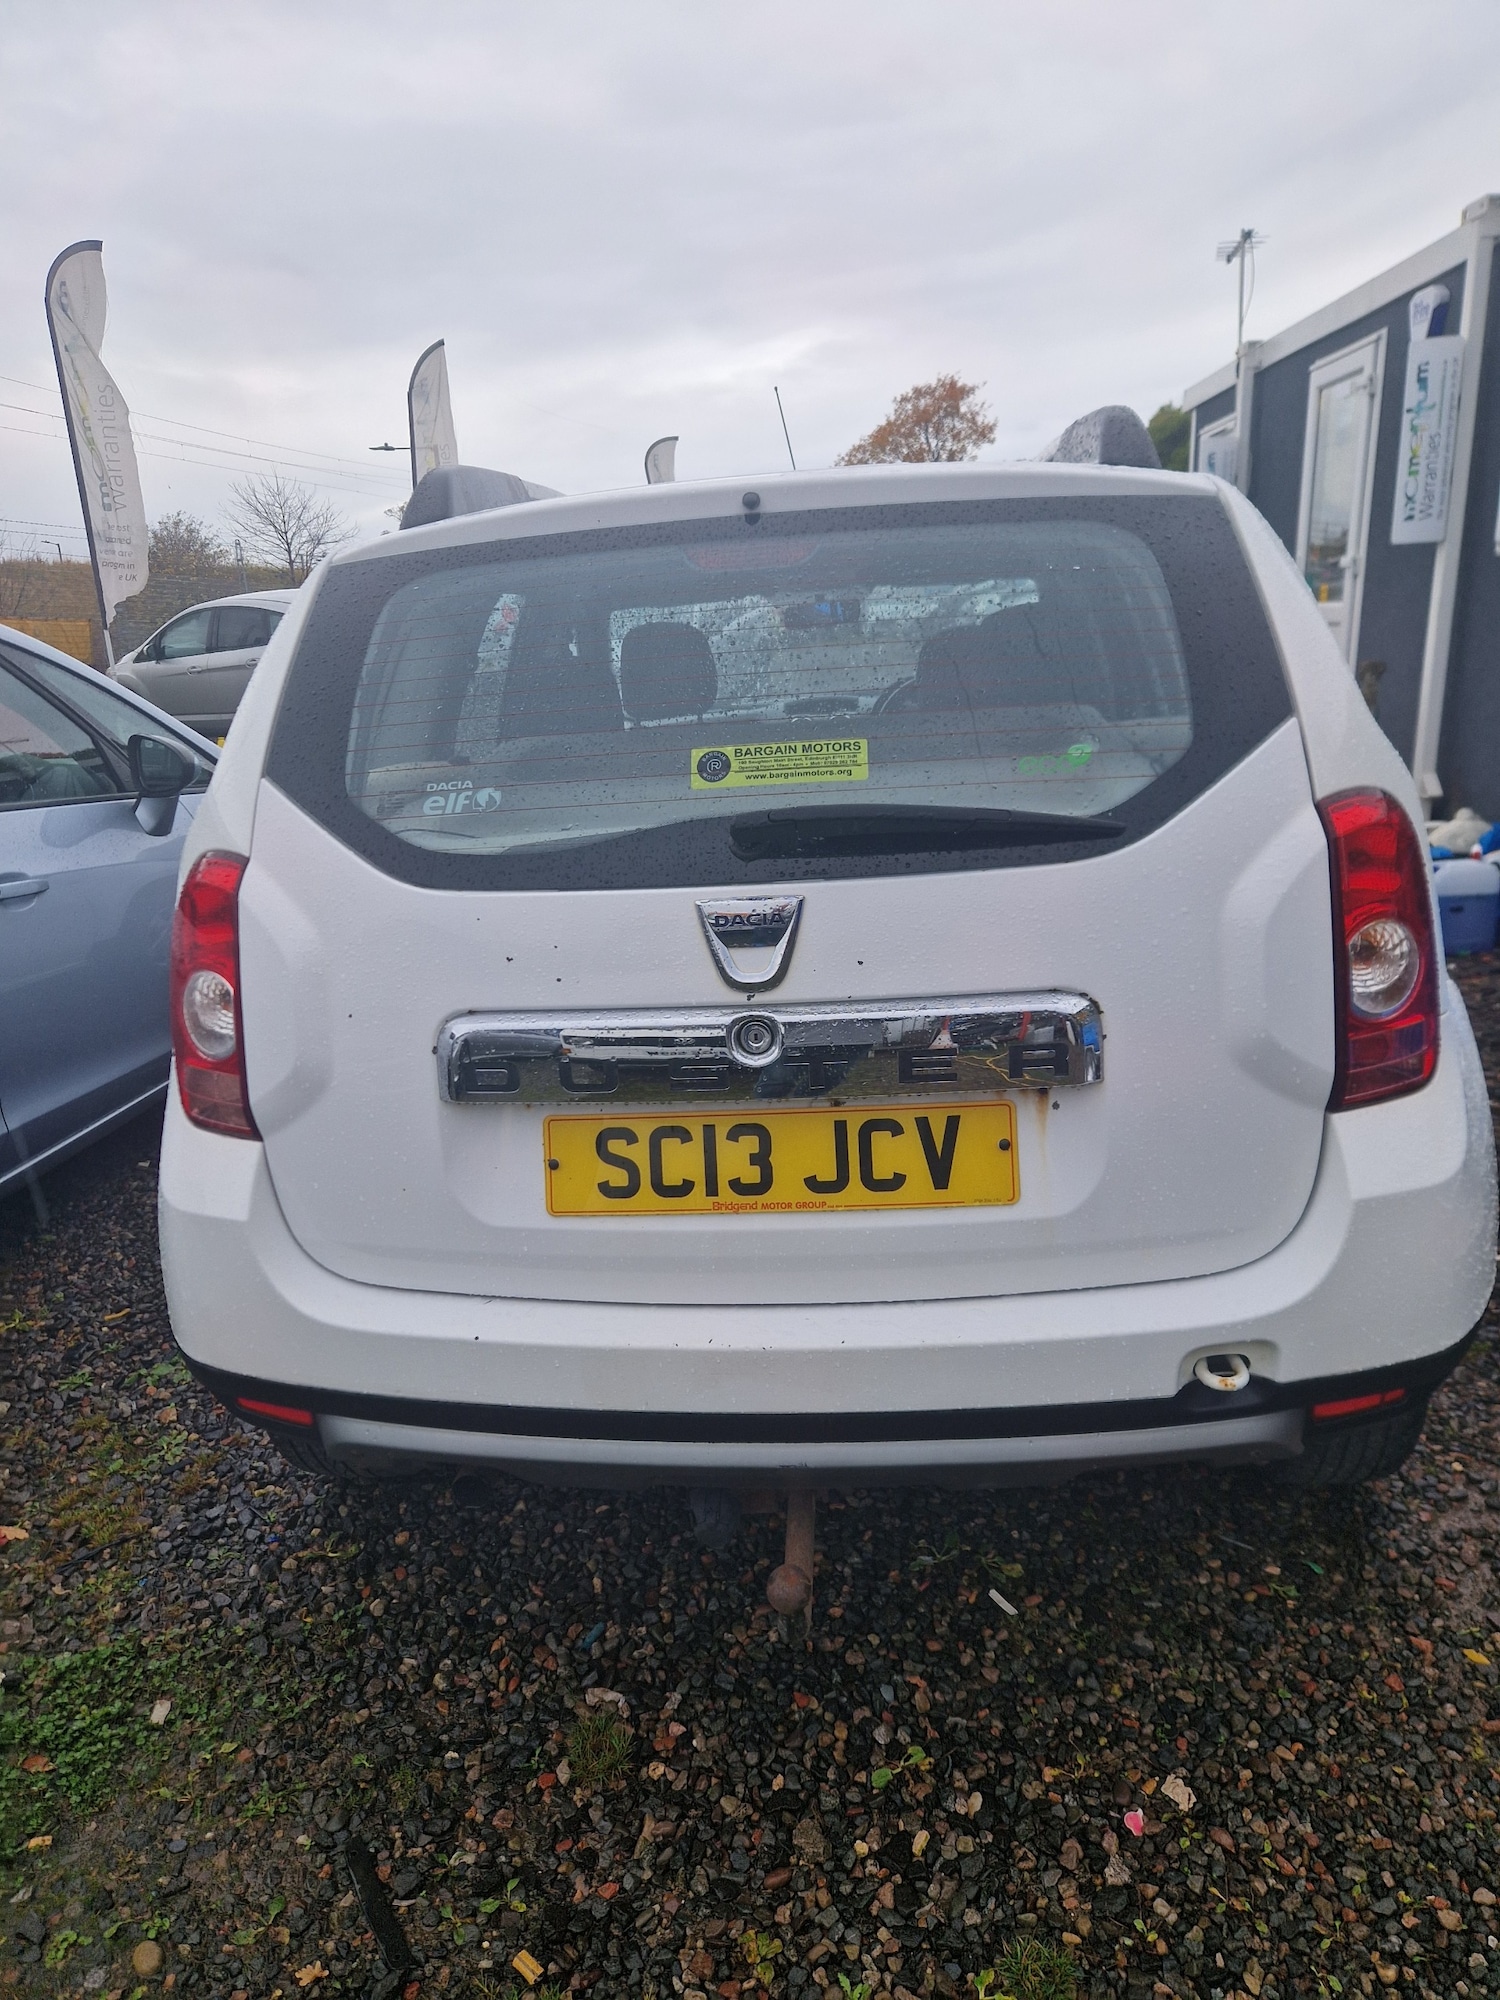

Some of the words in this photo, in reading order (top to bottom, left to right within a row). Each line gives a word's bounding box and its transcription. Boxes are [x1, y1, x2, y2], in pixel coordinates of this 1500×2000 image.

[99, 383, 127, 512] warranties
[1419, 431, 1441, 521] Warranties
[734, 744, 798, 758] BARGAIN
[801, 741, 862, 754] MOTORS
[744, 769, 852, 780] www.bargainmotors.org
[426, 780, 473, 792] DACIA
[422, 790, 473, 816] elf
[714, 911, 787, 928] DACIA
[462, 1043, 1070, 1094] DUSTER
[595, 1122, 774, 1199] SC13
[803, 1114, 961, 1195] JCV
[712, 1201, 758, 1213] Bridgend
[761, 1202, 793, 1210] MOTOR
[795, 1201, 828, 1209] GROUP
